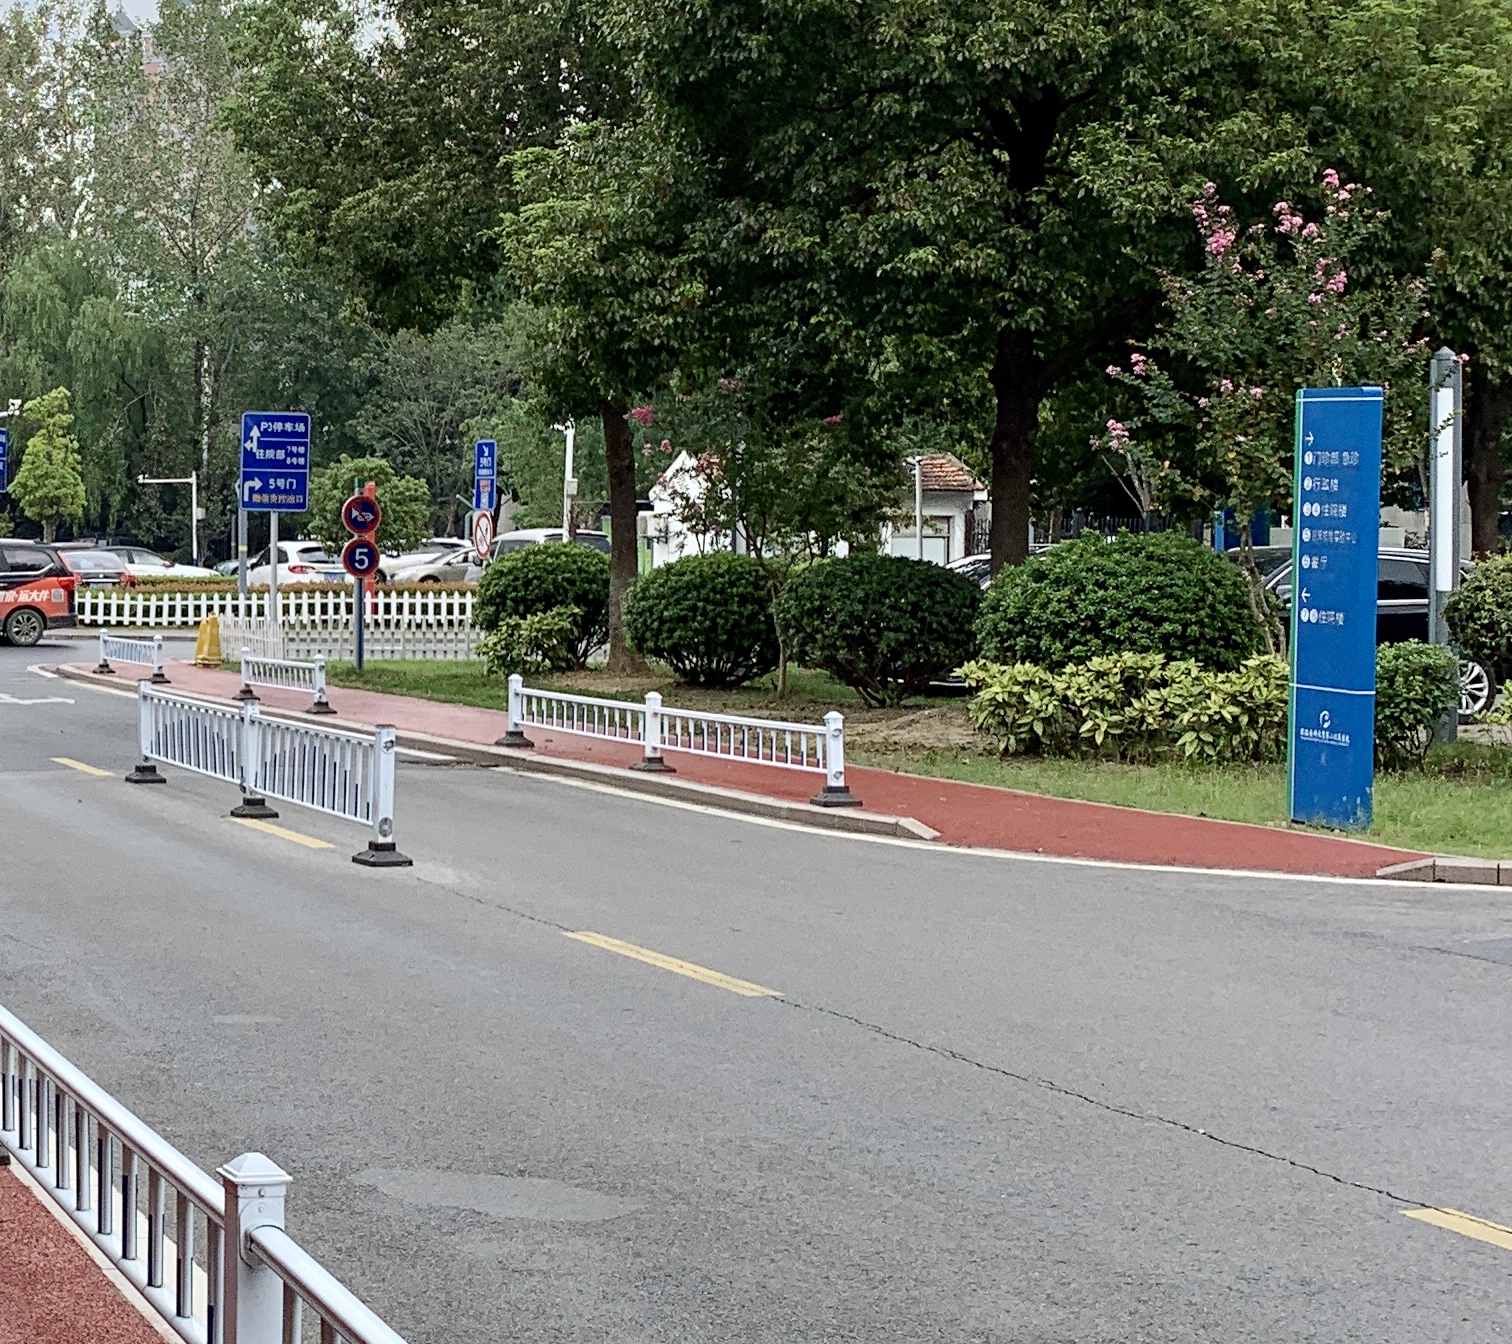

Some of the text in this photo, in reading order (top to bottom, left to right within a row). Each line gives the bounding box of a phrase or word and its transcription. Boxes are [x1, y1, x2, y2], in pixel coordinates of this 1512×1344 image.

[260, 421, 306, 433] P3停车场
[256, 449, 286, 460] 住院部
[269, 478, 297, 490] 5号门
[354, 548, 369, 570] 5
